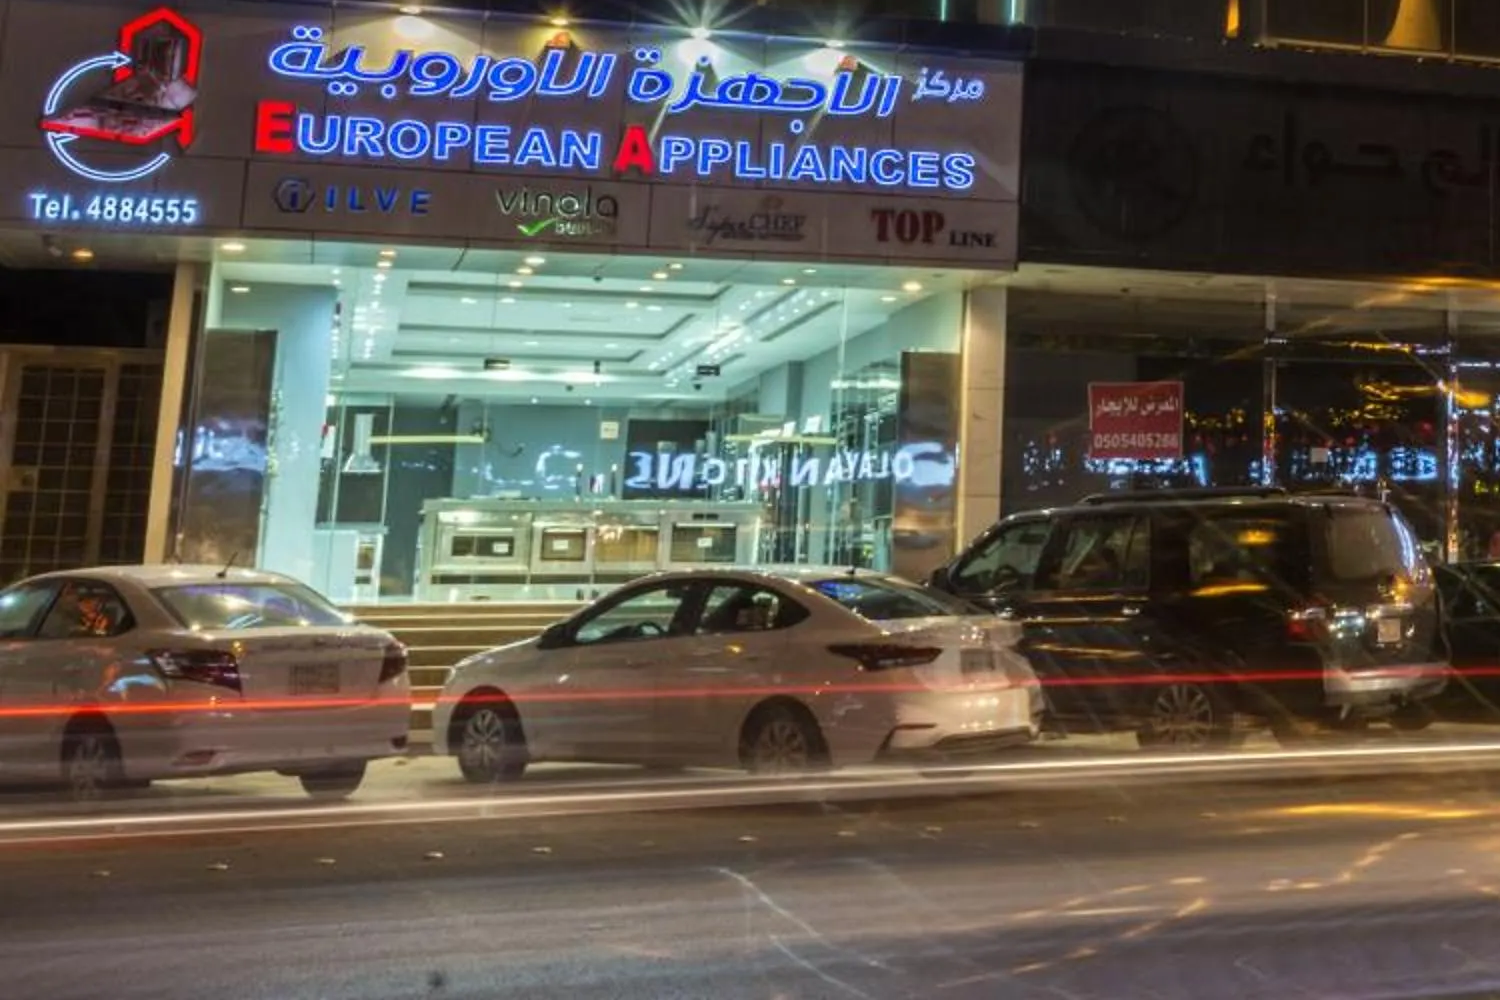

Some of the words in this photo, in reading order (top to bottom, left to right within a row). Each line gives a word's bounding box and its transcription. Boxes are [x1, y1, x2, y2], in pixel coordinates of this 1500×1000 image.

[911, 66, 986, 103] مركز
[254, 101, 600, 168] EUROPEAN
[613, 125, 976, 190] APPLIANCES
[29, 193, 81, 220] Tel.
[86, 195, 198, 223] 4884555
[324, 185, 433, 215] ILVE
[871, 208, 946, 245] TOP
[948, 229, 998, 247] LINE
